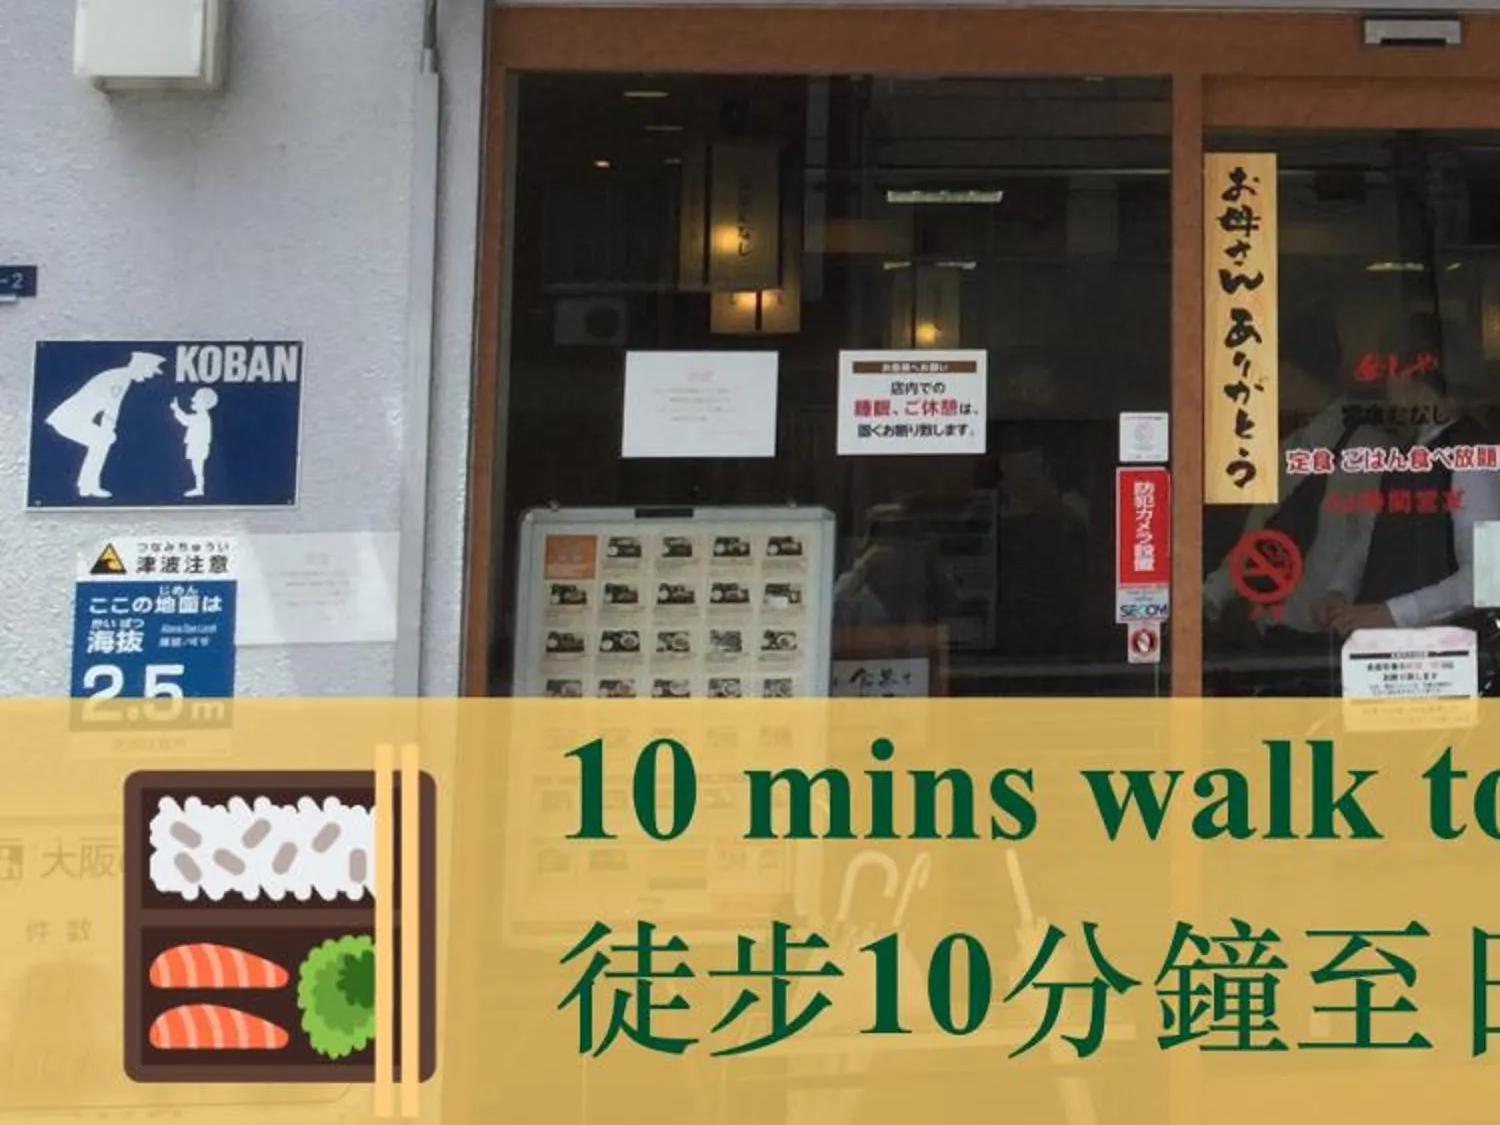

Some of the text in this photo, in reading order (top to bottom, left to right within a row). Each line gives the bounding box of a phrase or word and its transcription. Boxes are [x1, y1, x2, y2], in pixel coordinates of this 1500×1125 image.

[175, 344, 298, 383] KOBAN
[890, 381, 947, 396] 店内での
[1286, 448, 1334, 474] 定食
[136, 555, 230, 574] 津波注意
[89, 595, 223, 614] ここの地面は
[86, 630, 144, 654] 海抜
